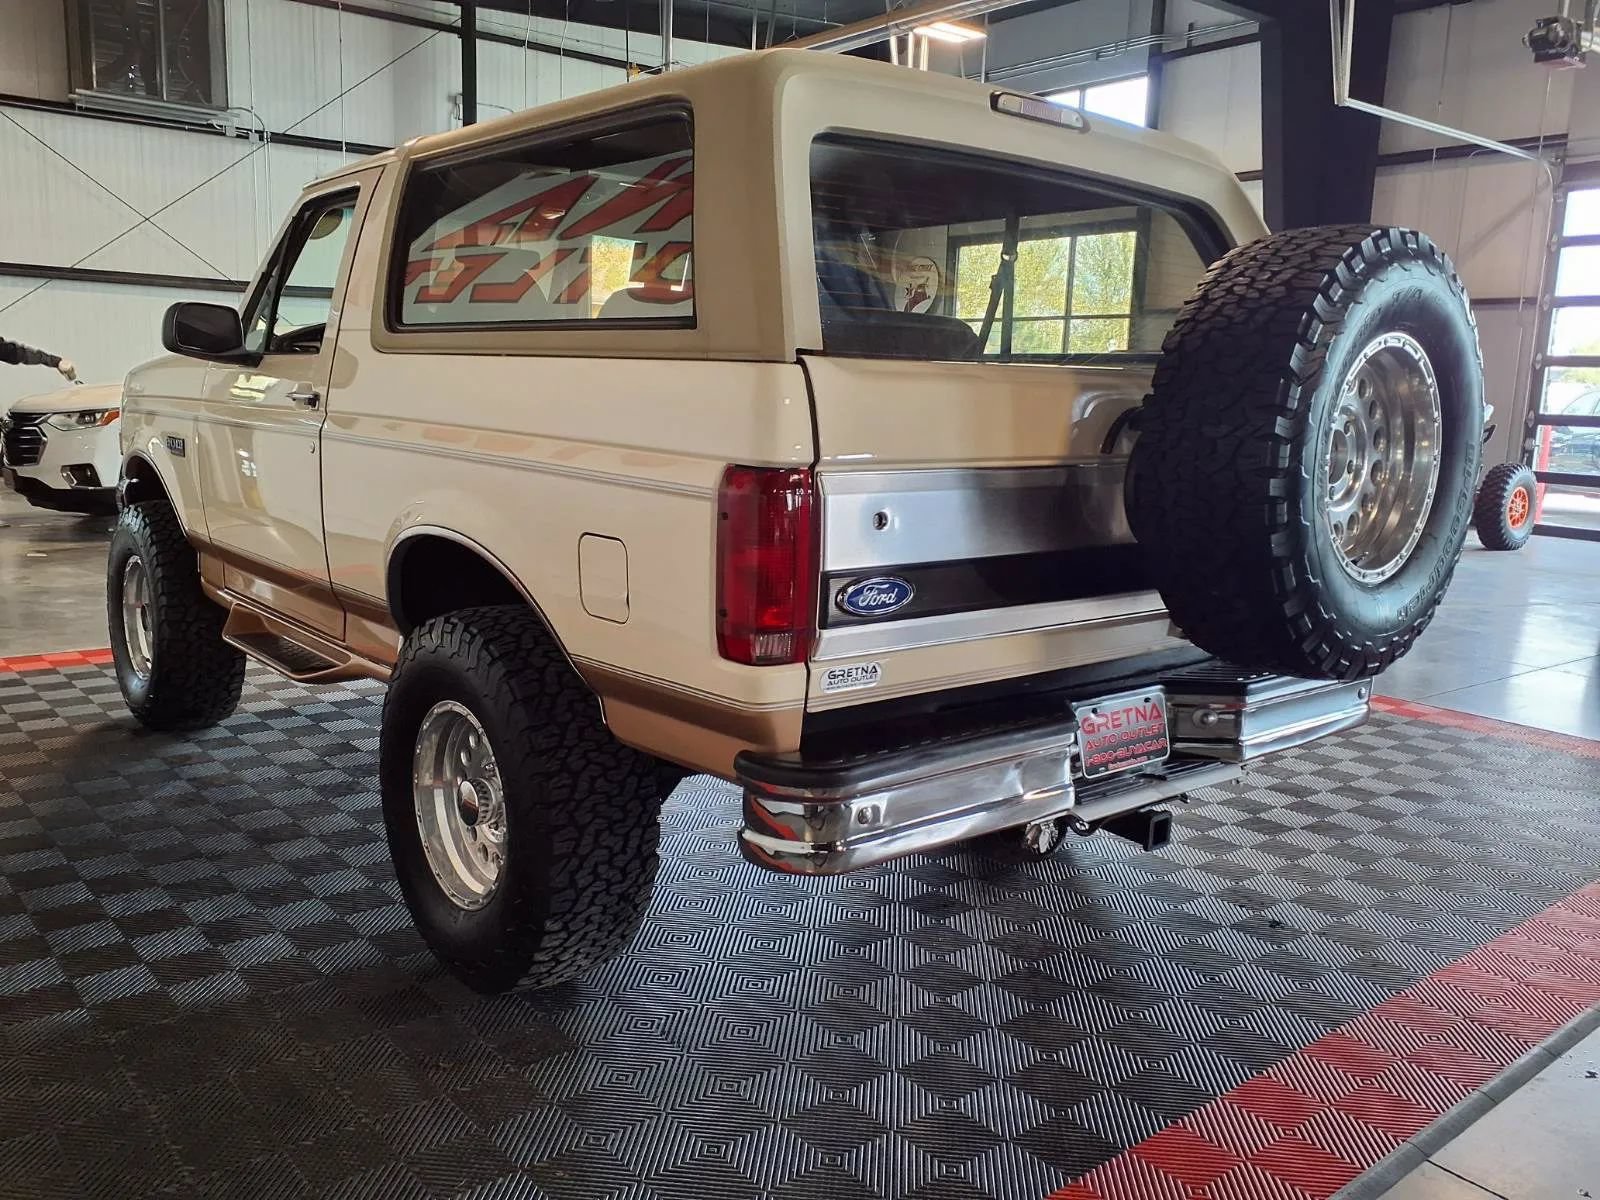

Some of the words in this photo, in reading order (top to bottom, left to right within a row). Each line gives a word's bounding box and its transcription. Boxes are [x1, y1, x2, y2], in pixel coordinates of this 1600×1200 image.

[858, 583, 898, 606] Ford
[827, 665, 878, 679] GRETNA
[827, 678, 850, 686] AUTO
[850, 674, 877, 683] OUTLET
[1081, 702, 1162, 735] GRETNA
[1085, 733, 1117, 751] AUTO
[1120, 722, 1166, 741] OUTLET
